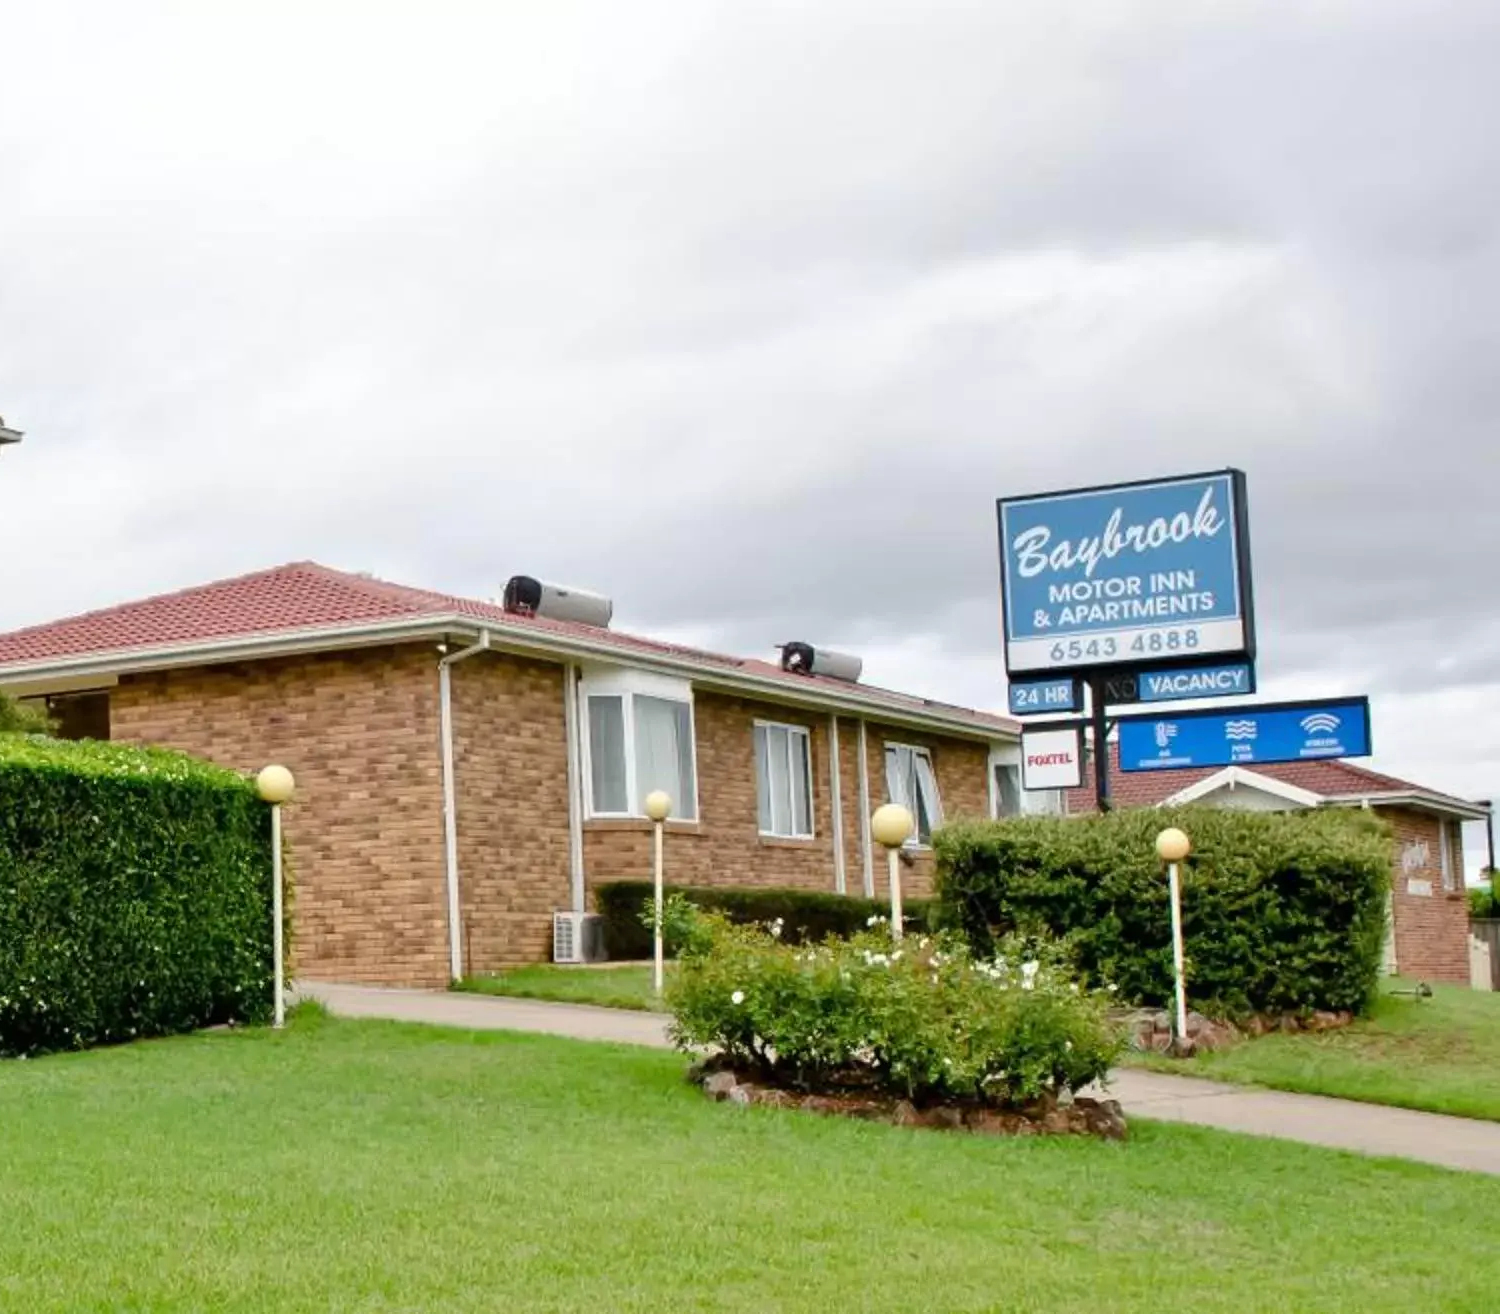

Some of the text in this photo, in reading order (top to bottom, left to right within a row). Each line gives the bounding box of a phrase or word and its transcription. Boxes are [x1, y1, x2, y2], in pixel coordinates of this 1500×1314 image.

[1013, 486, 1225, 577] Baybrook
[1049, 569, 1196, 604] MOTOR INN
[1033, 592, 1215, 628] & APARTMENTS
[1050, 629, 1199, 661] 6543 4888
[1015, 685, 1070, 706] 24 HR
[1148, 669, 1244, 694] VACANCY
[1028, 752, 1072, 767] FOXTEL
